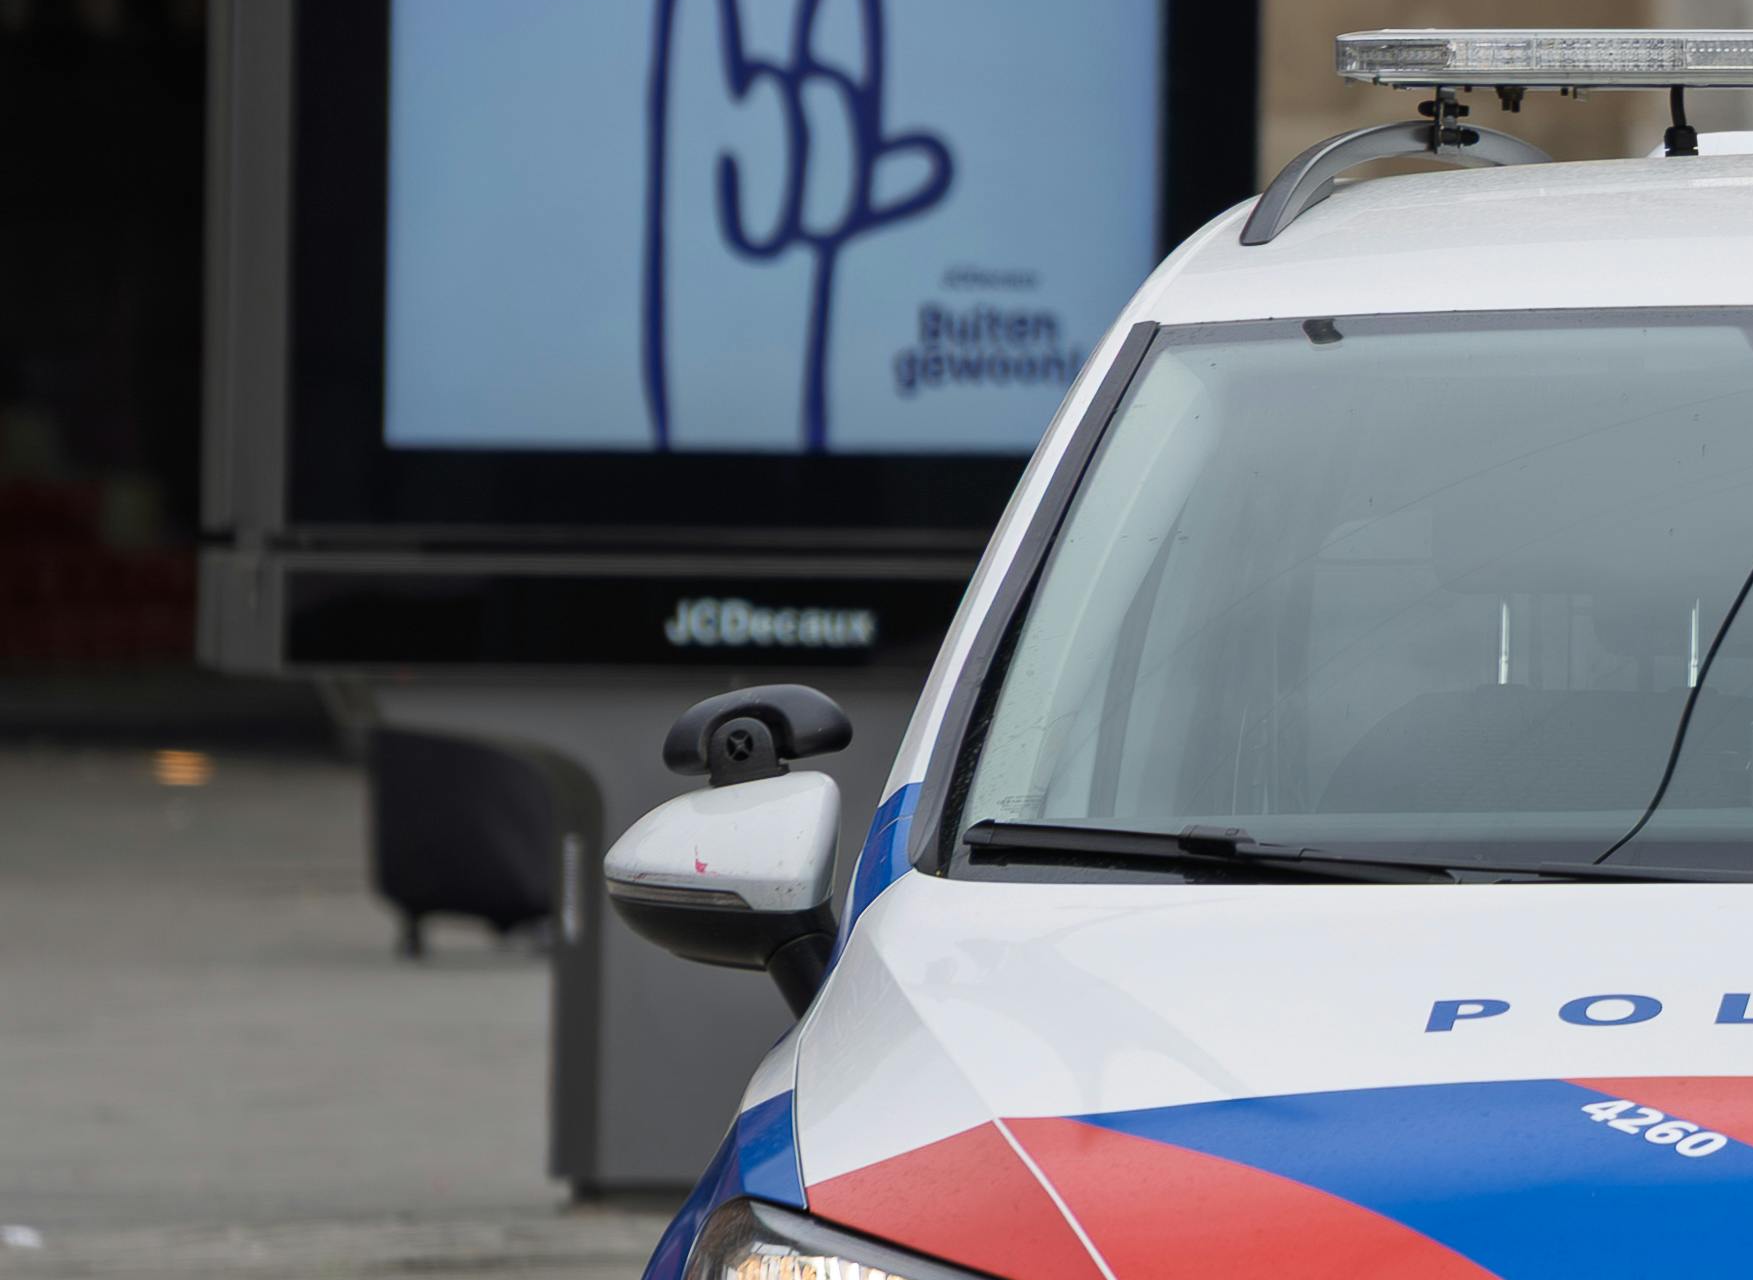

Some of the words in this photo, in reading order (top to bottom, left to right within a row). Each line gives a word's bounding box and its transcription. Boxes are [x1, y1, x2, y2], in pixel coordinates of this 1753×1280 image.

[918, 301, 1058, 346] Buiten
[664, 597, 875, 647] JCDecaux
[1581, 1099, 1728, 1157] 4260
